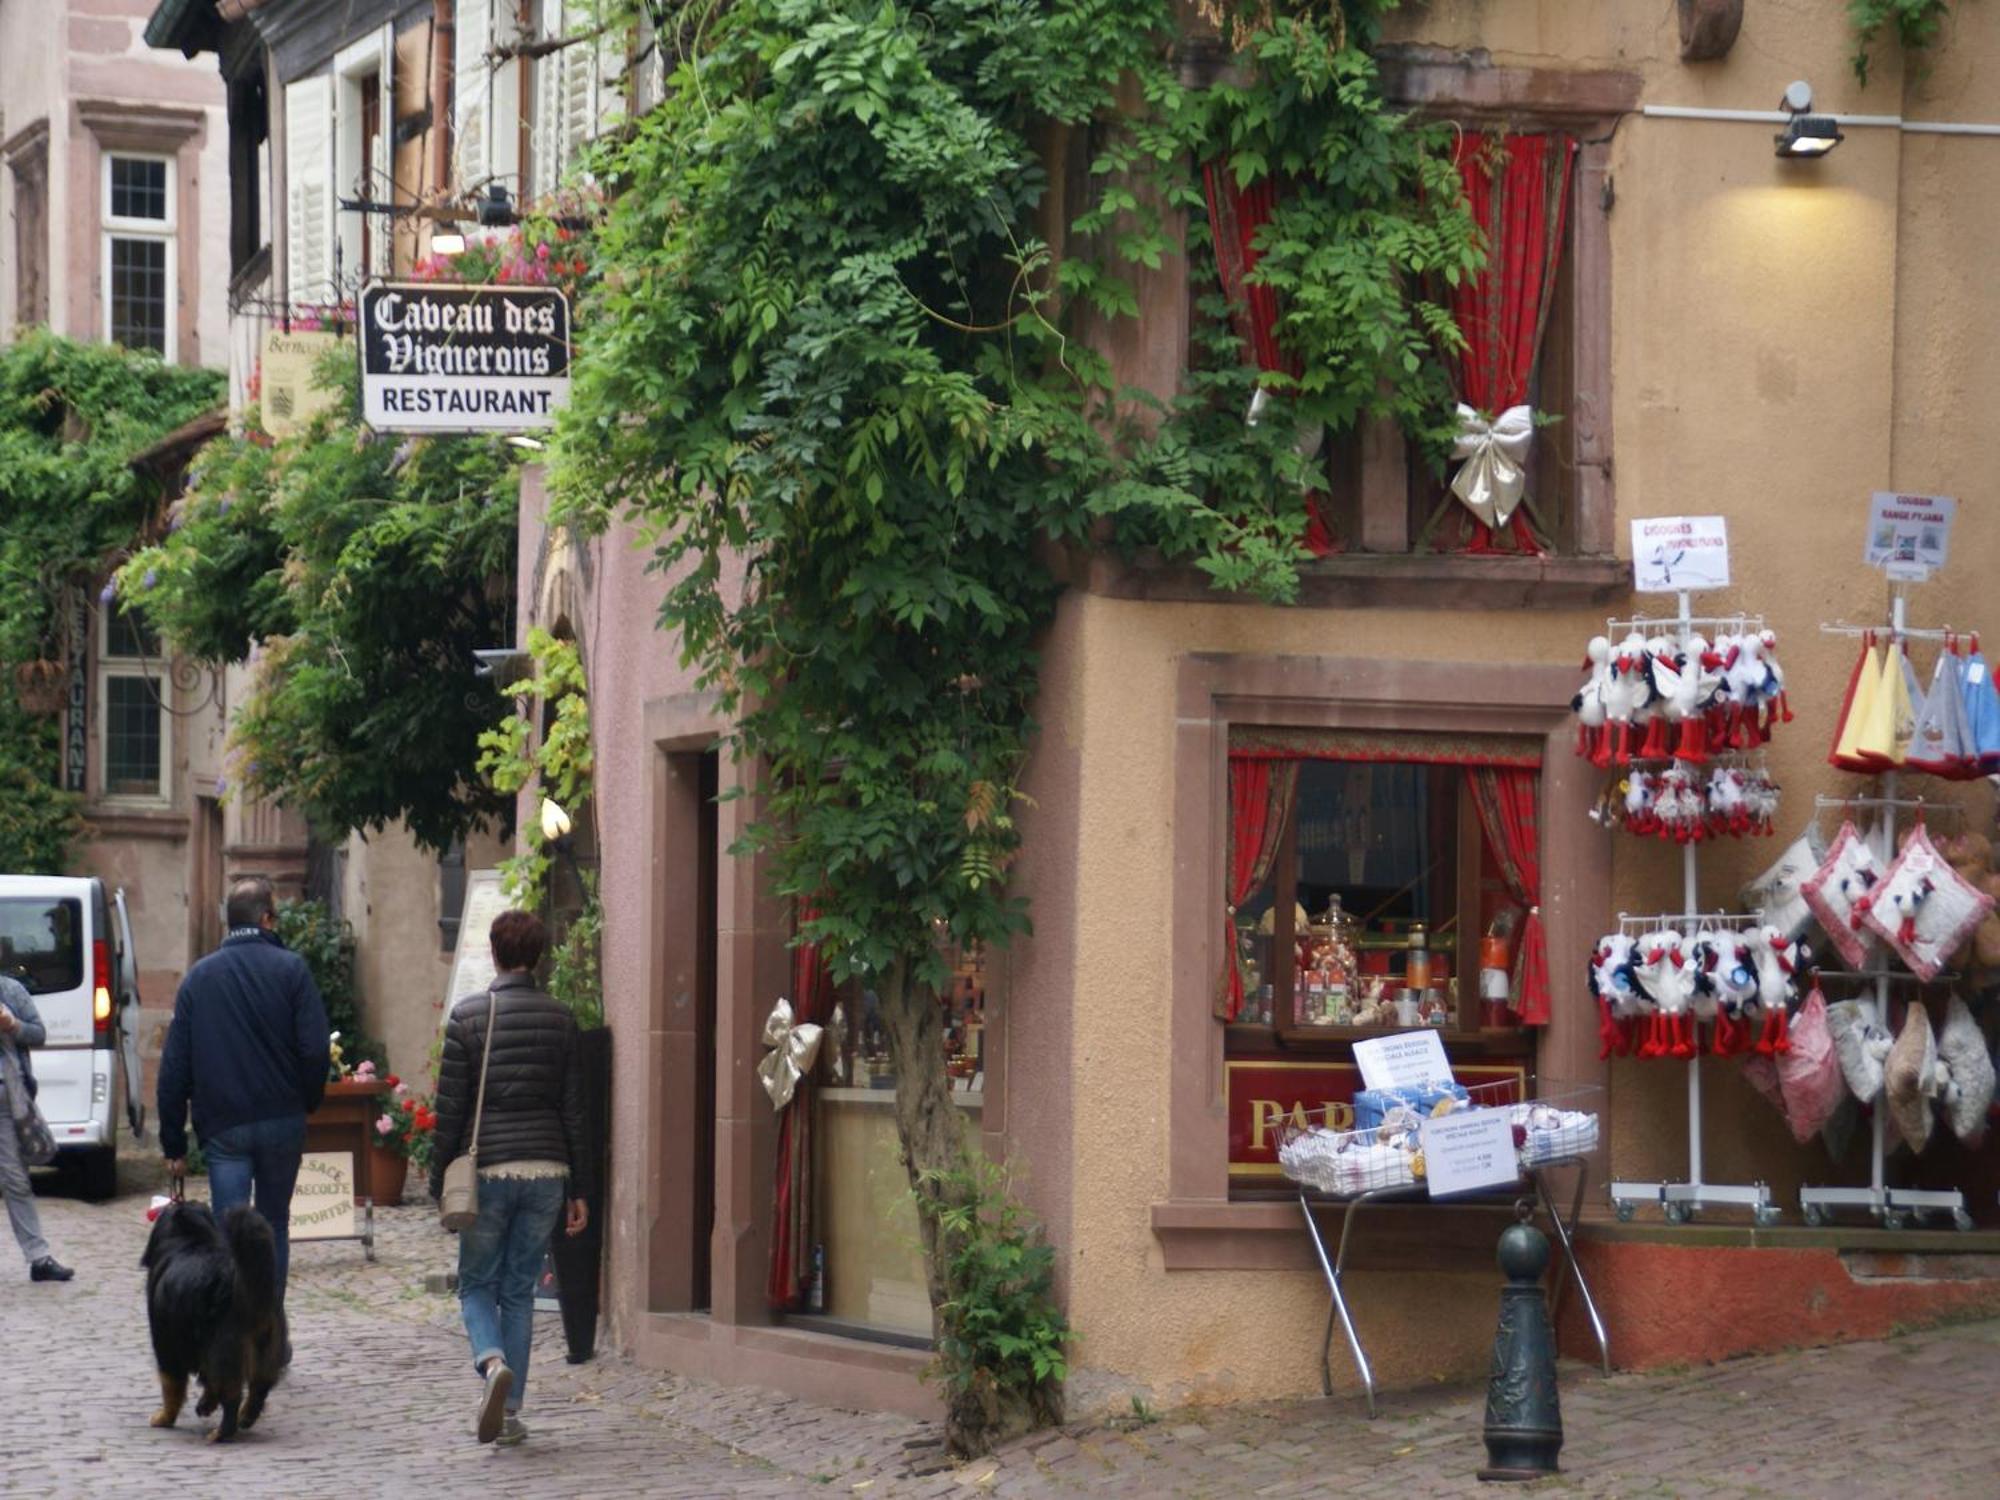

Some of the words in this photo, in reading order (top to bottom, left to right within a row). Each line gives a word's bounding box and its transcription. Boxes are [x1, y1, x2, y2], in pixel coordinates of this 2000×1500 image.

[374, 292, 495, 333] Caveau
[502, 298, 556, 334] des
[382, 333, 551, 376] Vignerons
[382, 388, 552, 414] RESTAURANT
